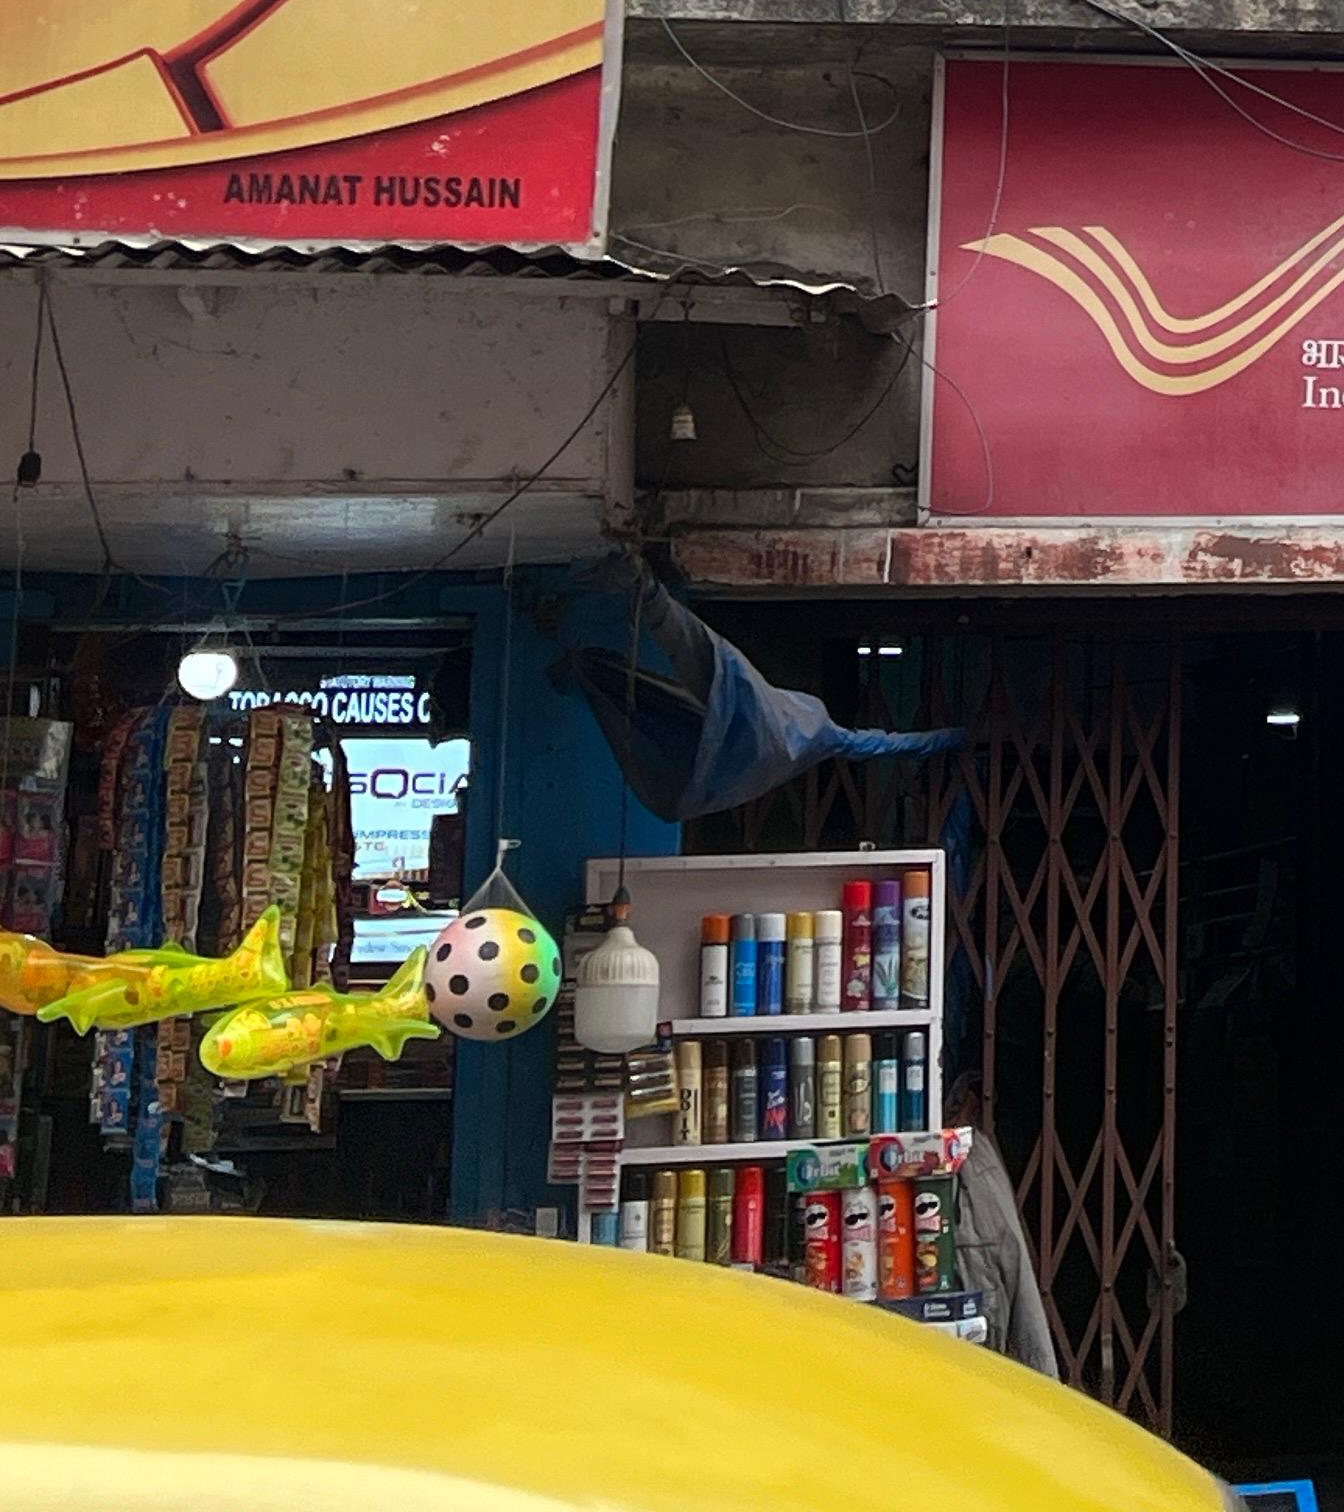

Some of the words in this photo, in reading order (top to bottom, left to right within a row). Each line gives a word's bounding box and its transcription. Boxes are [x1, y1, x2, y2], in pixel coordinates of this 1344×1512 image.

[223, 173, 362, 205] AMANAT
[375, 175, 521, 209] HUSSAIN
[332, 691, 413, 723] CAUSES
